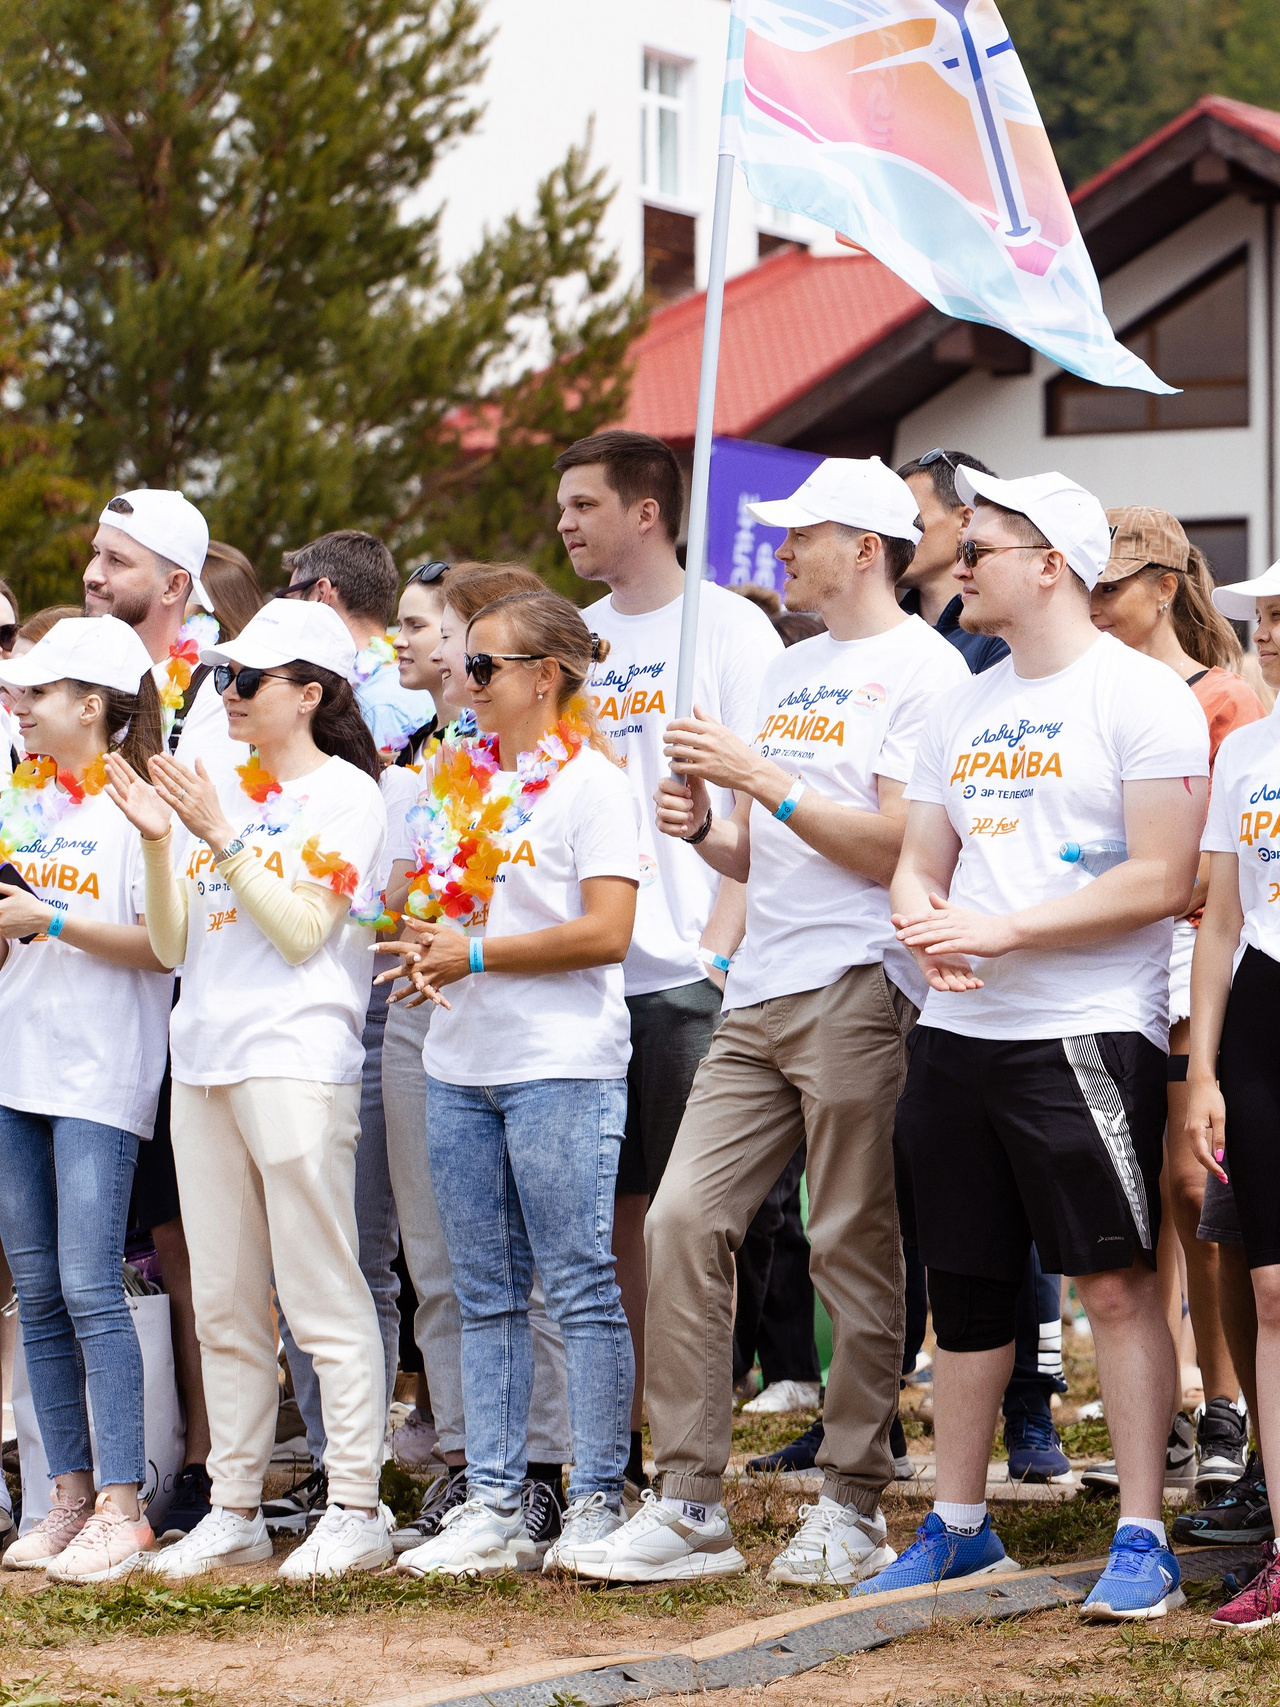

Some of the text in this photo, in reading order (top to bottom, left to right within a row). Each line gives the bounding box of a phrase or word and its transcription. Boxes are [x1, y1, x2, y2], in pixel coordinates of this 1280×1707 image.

[590, 687, 666, 720] АЙВА
[778, 685, 853, 710] Лови Волну
[754, 709, 845, 747] ДРАЙВА
[972, 719, 1064, 748] Лови Волну
[950, 744, 1063, 787] ДРАЙВА
[17, 836, 98, 859] ови Волну
[10, 857, 100, 900] АЙВА
